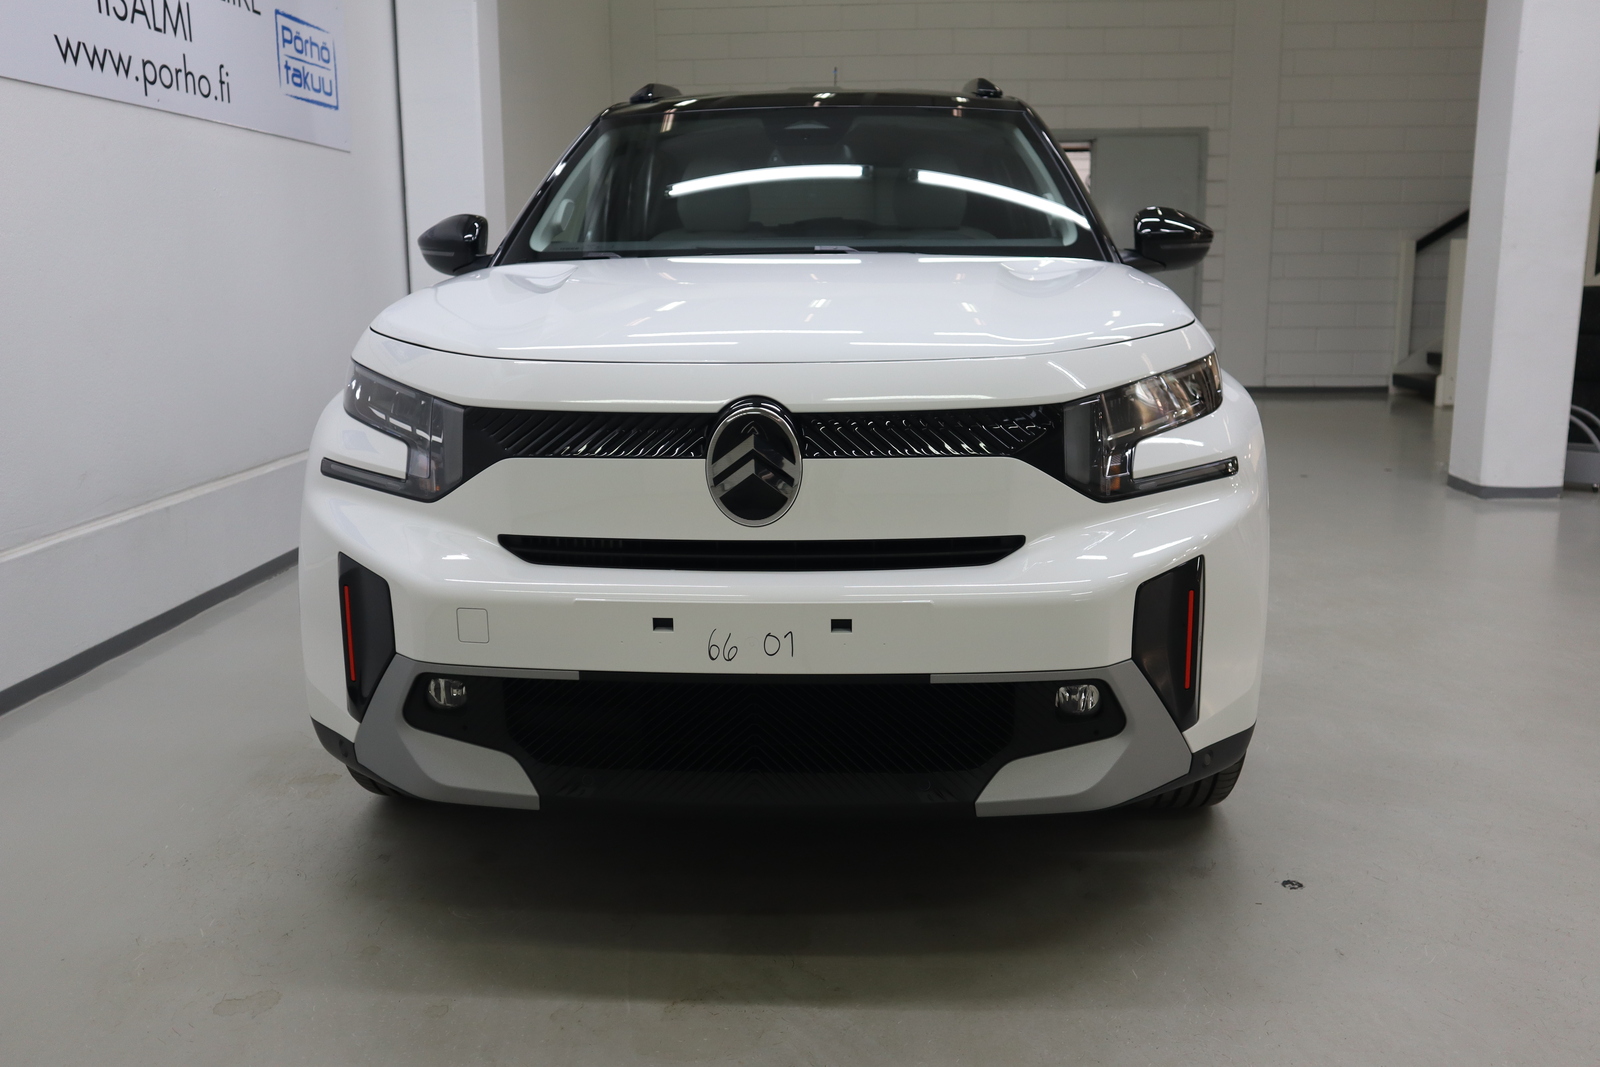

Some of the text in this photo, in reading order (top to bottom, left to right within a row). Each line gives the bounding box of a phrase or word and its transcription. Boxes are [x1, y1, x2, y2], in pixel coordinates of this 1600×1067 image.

[281, 24, 331, 64] Pörhö
[53, 34, 231, 103] www.porho.fi
[284, 59, 333, 97] takuu
[708, 628, 738, 662] 66
